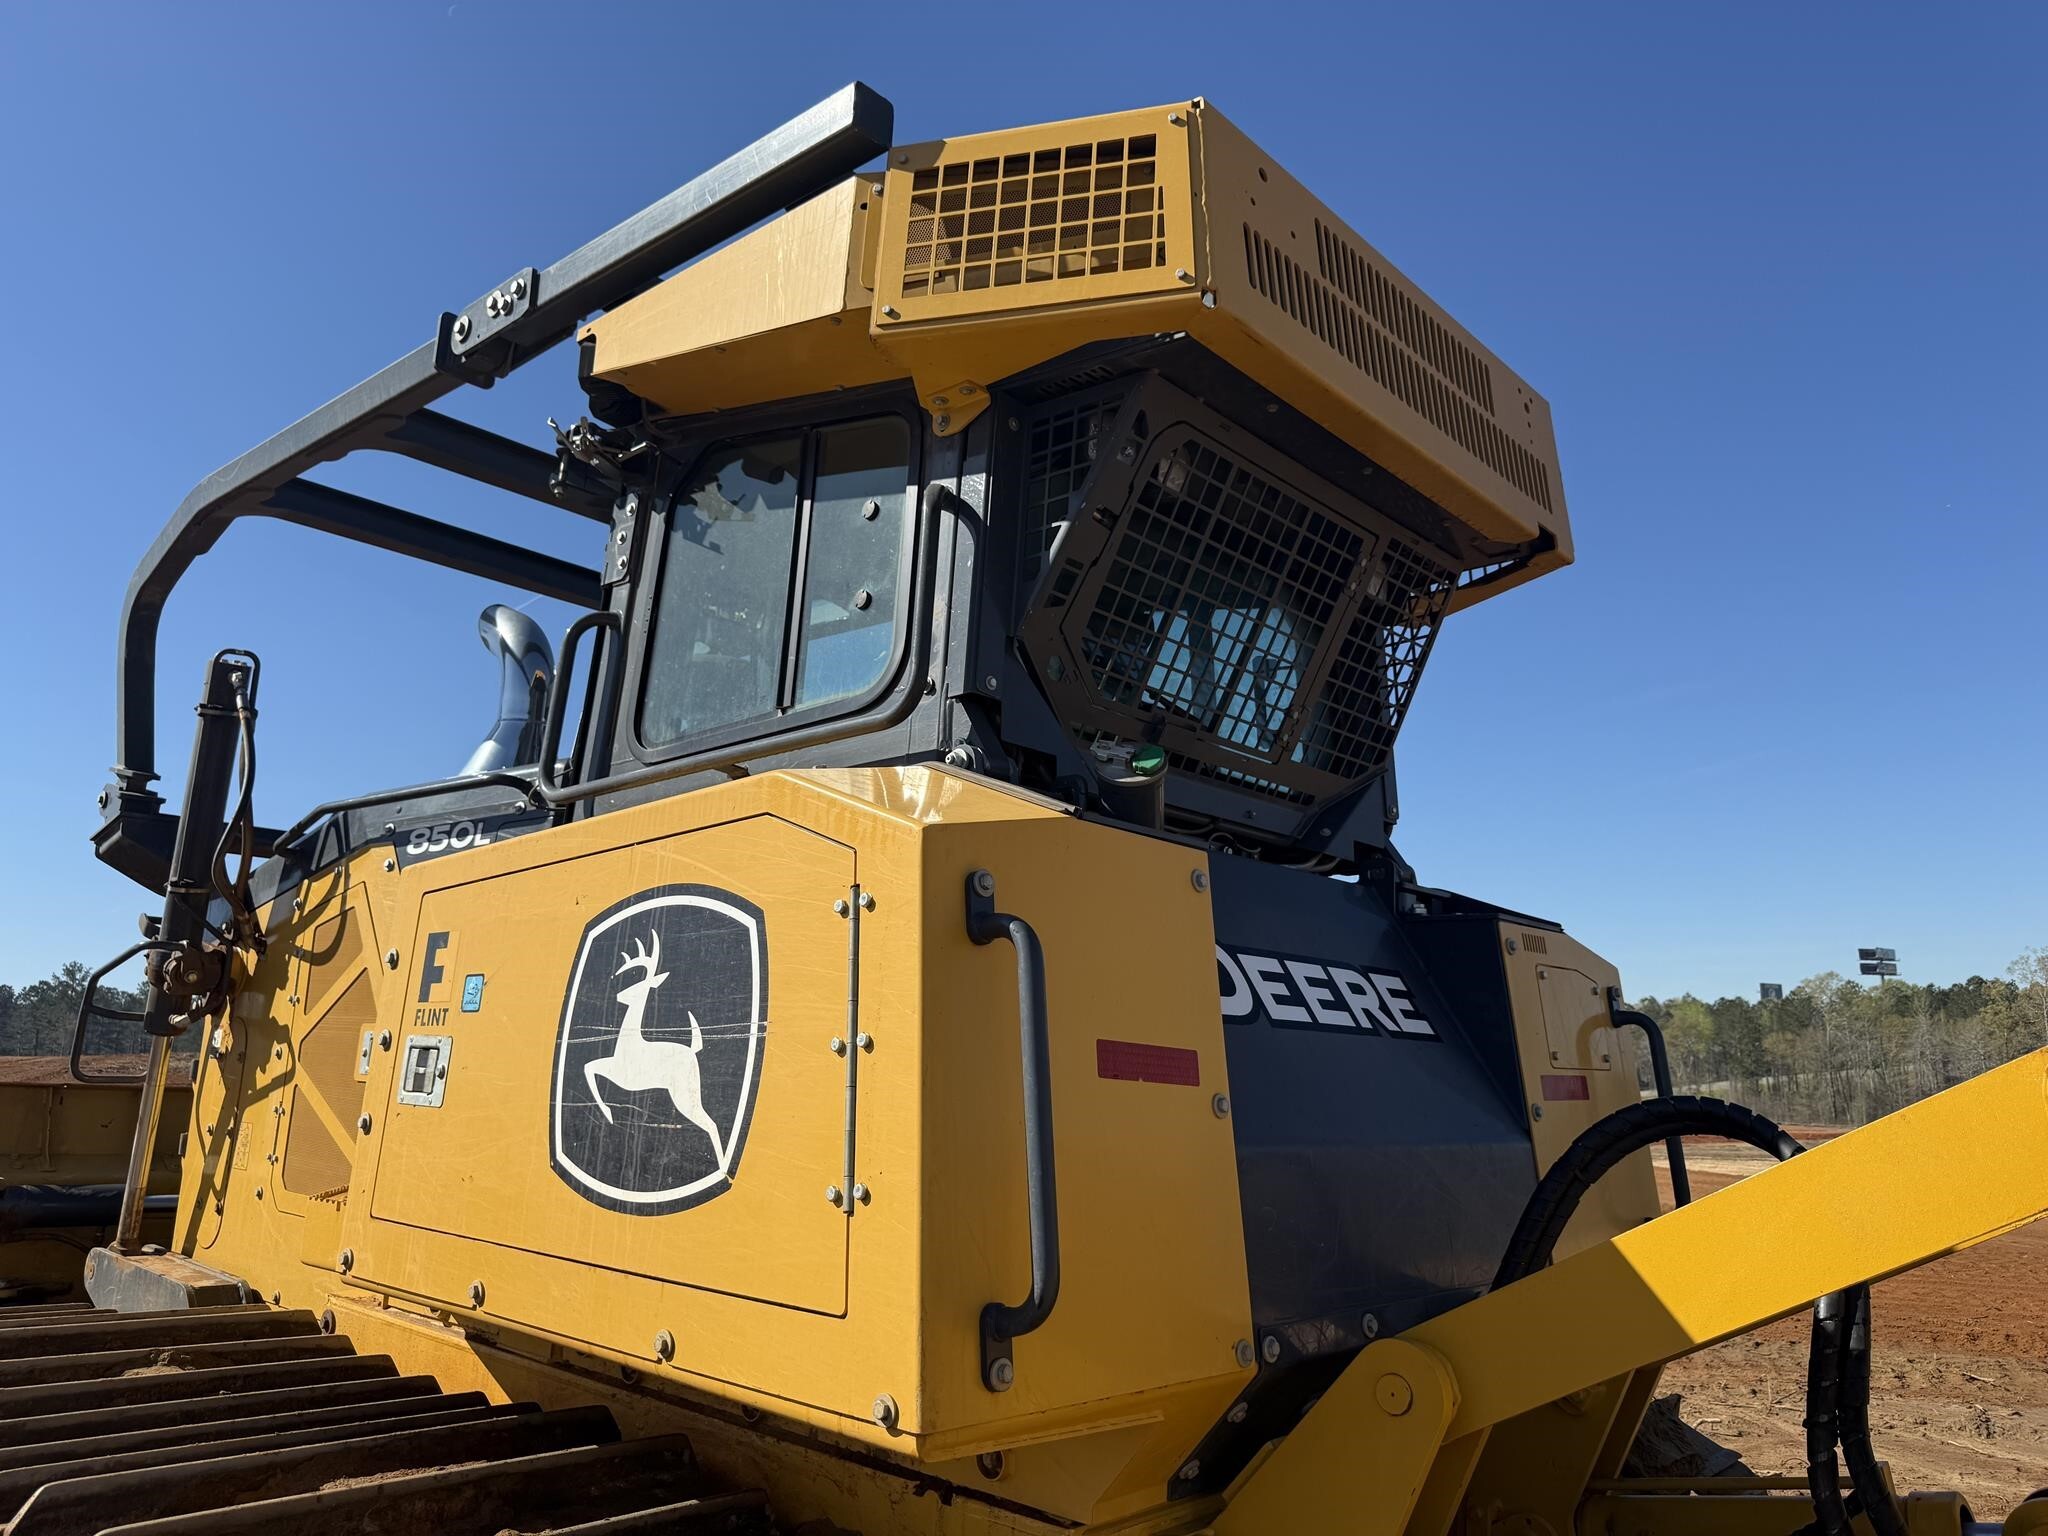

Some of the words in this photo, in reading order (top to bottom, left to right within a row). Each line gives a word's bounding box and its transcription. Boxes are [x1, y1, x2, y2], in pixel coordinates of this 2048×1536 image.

[406, 821, 491, 855] 850L
[417, 931, 450, 1003] F
[413, 1008, 449, 1027] FLINT
